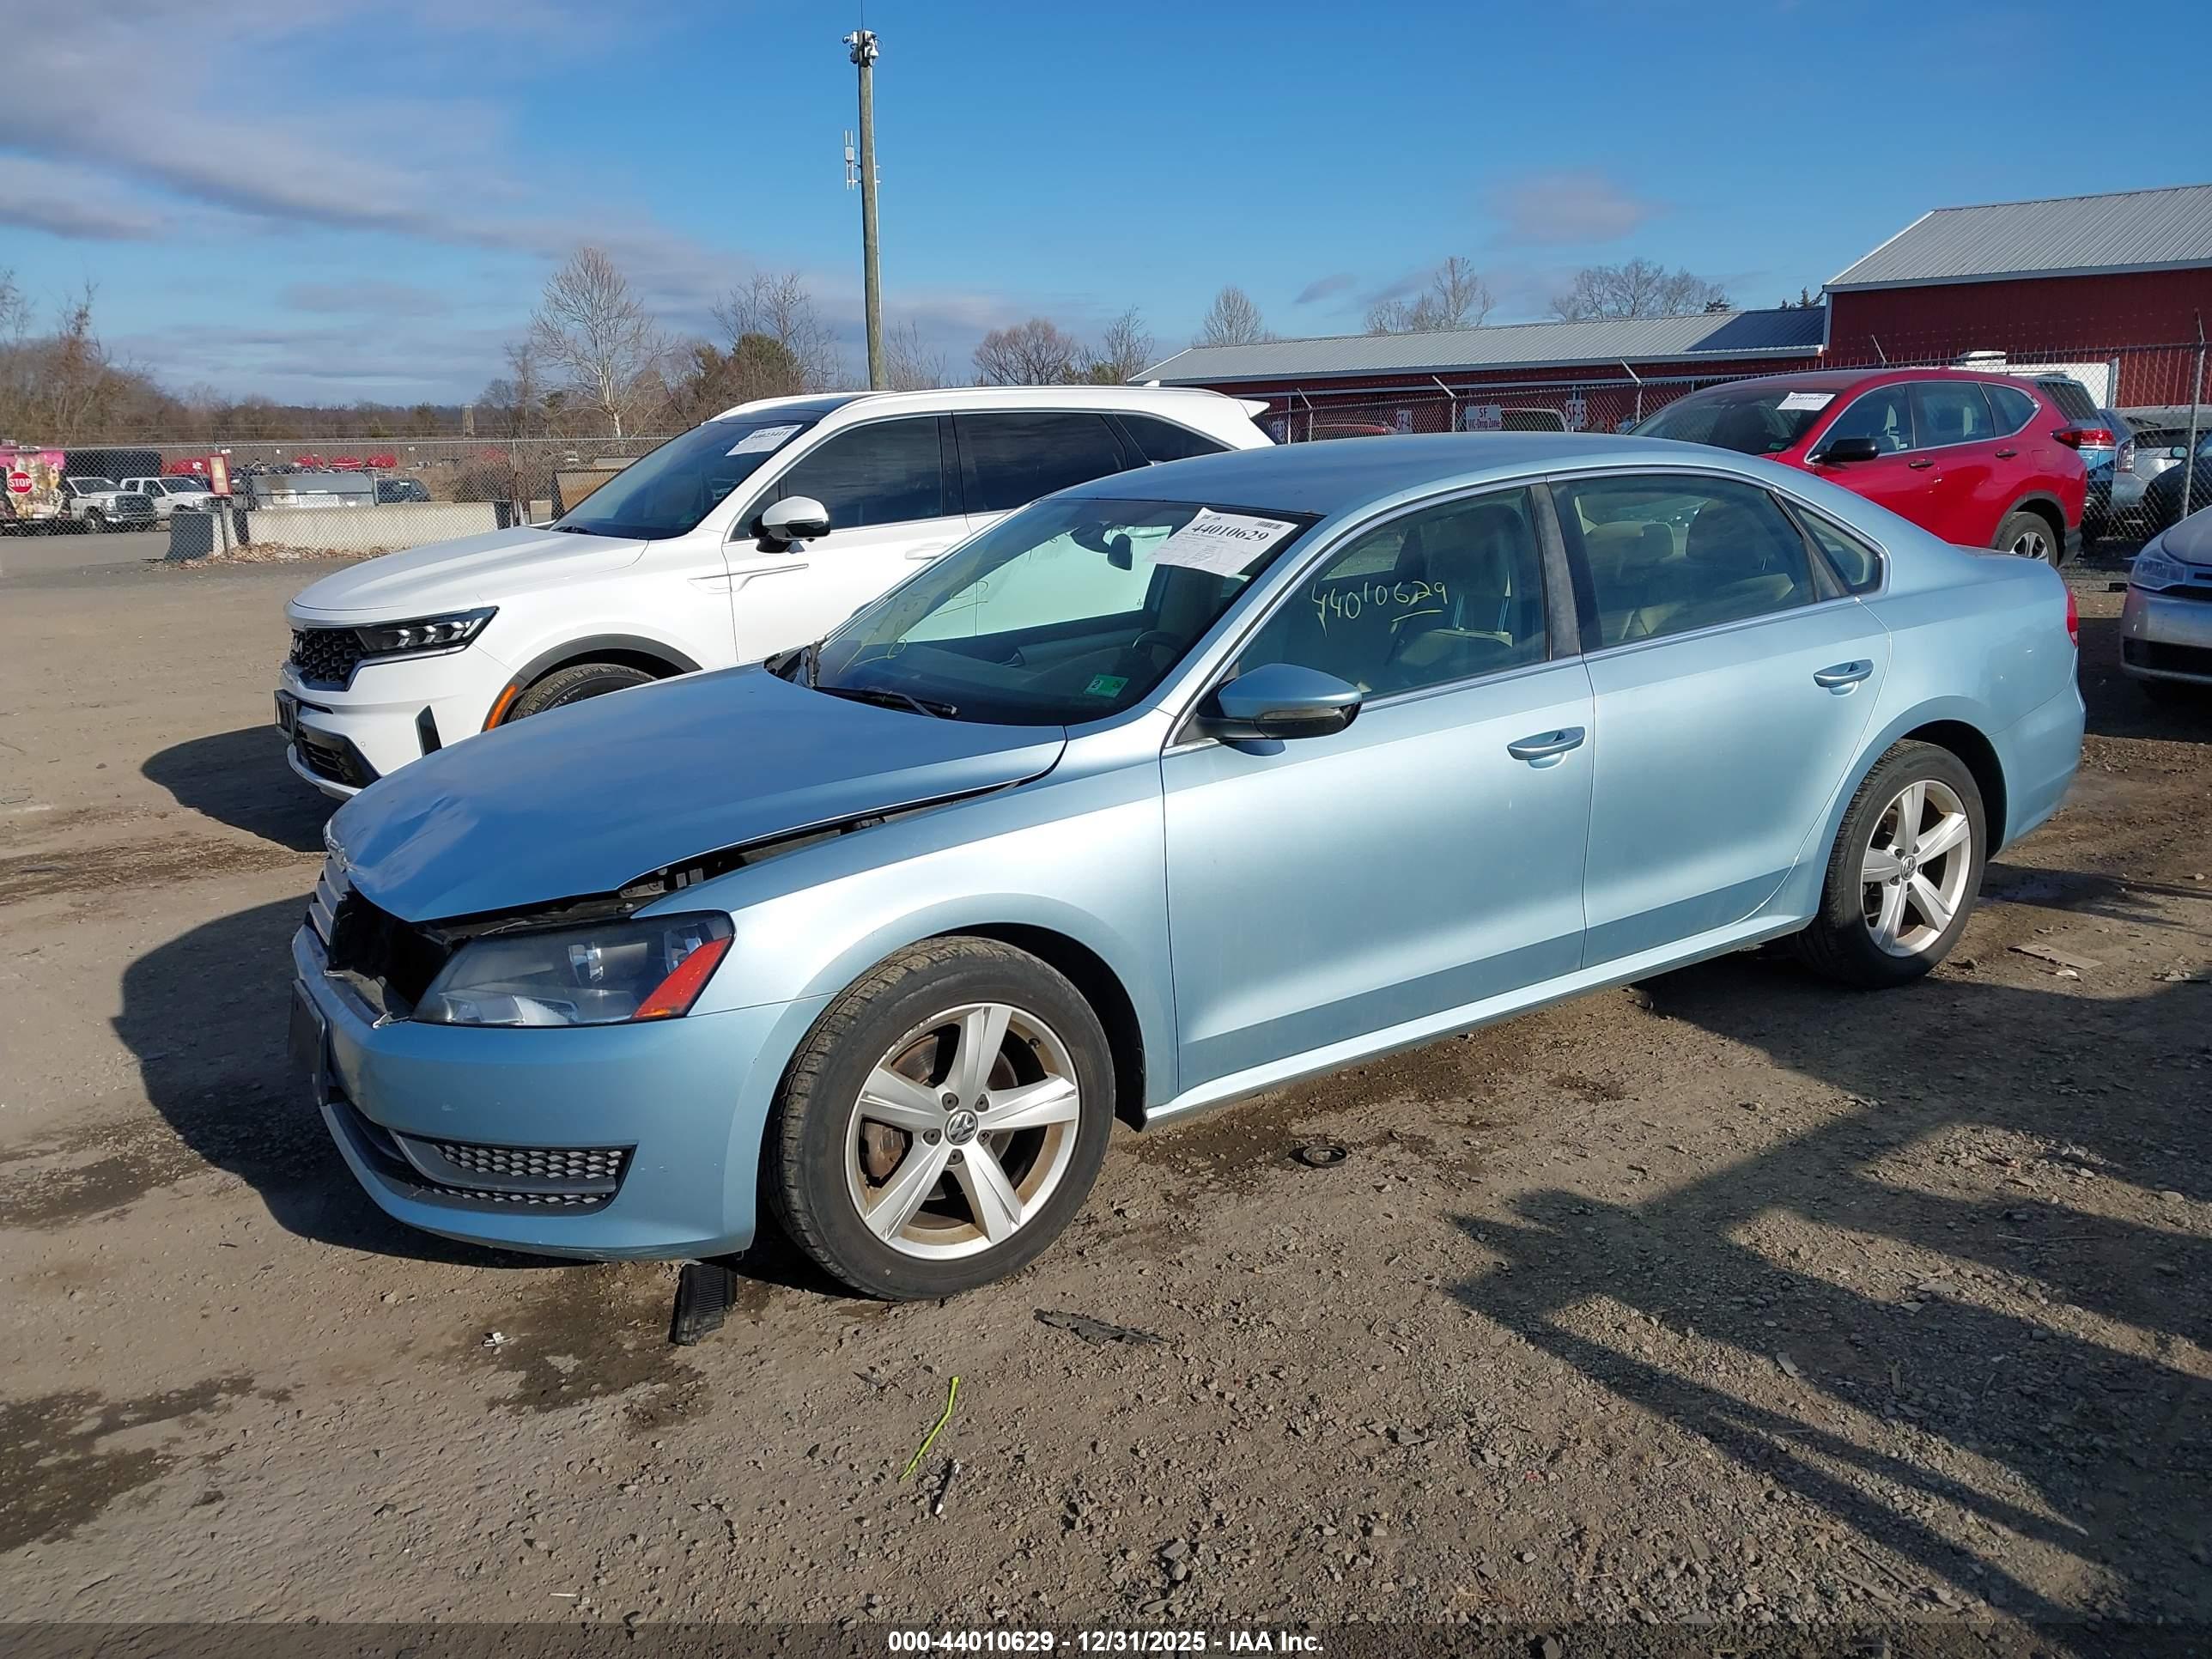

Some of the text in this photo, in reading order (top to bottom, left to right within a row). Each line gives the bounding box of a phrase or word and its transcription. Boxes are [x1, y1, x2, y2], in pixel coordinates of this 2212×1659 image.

[1479, 407, 1488, 418] SF
[1567, 404, 1585, 423] SF-5
[1488, 417, 1500, 428] Zone
[9, 477, 31, 488] STOP
[1192, 523, 1270, 542] 44010629
[1311, 580, 1449, 636] 44010629
